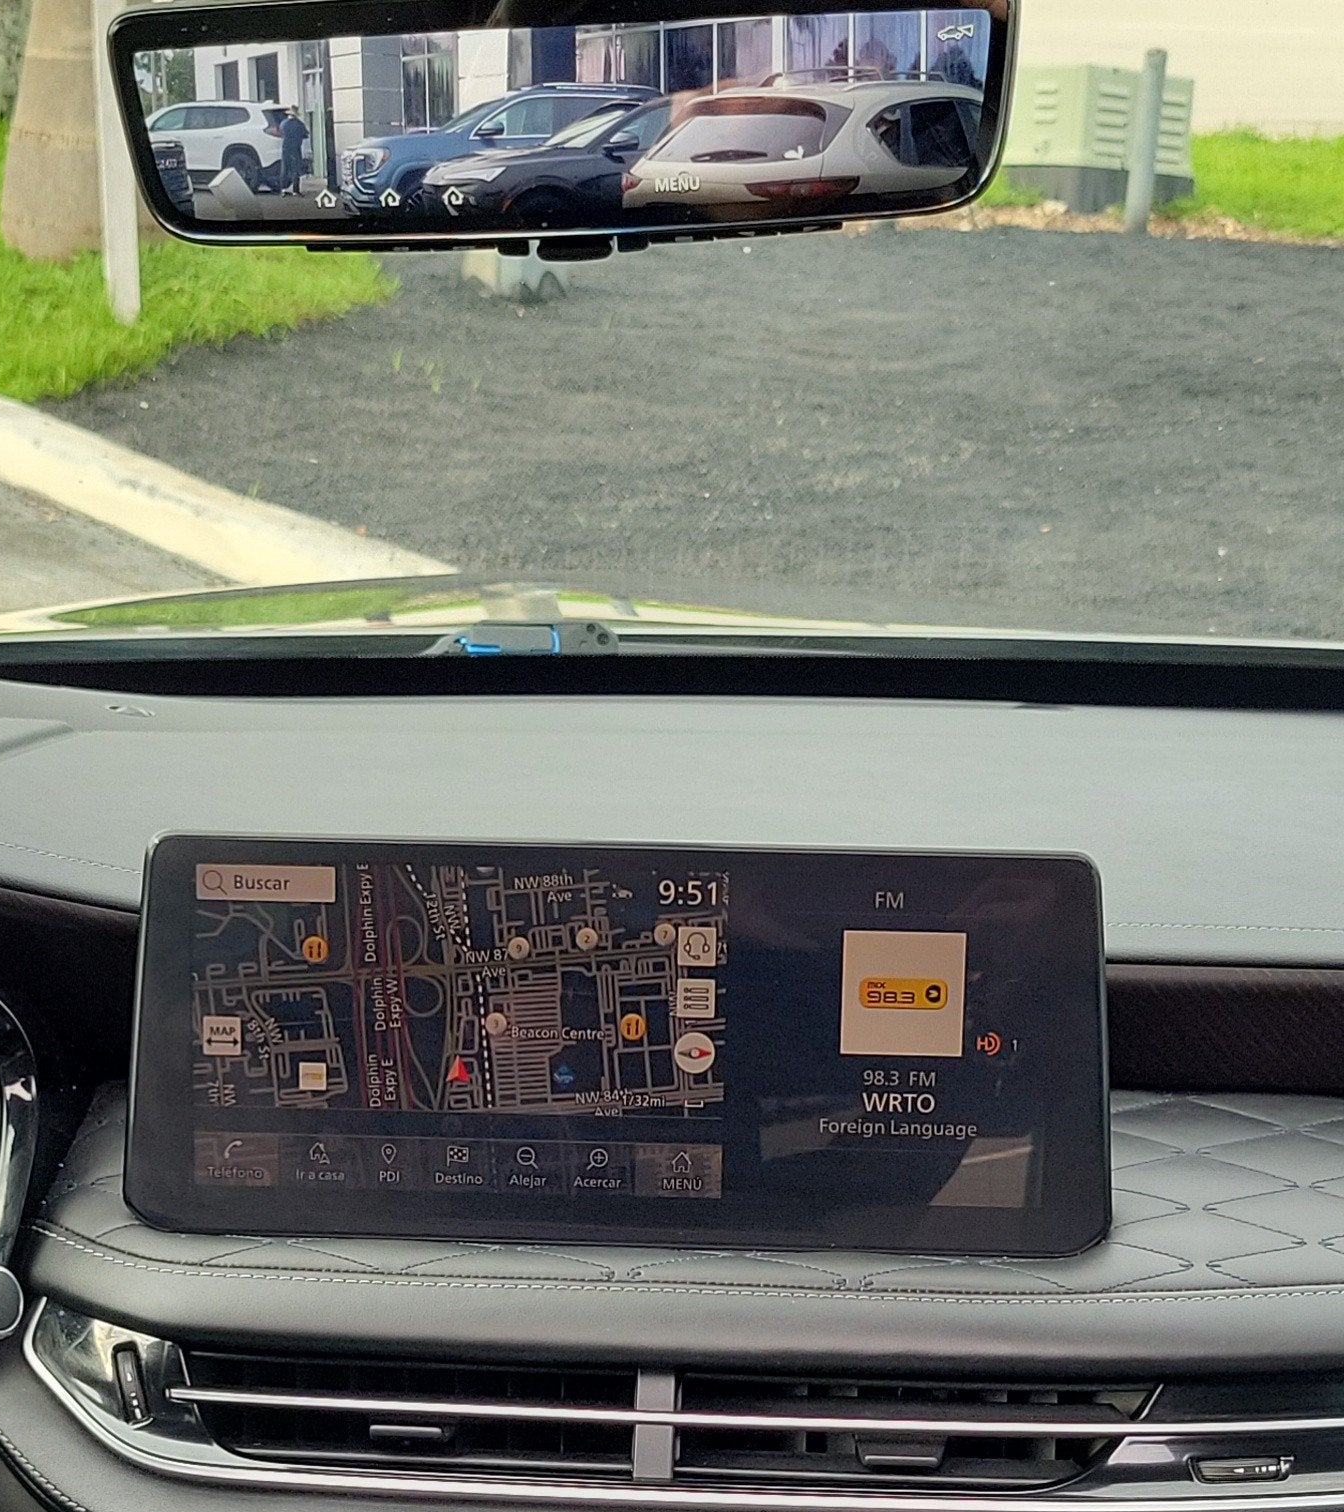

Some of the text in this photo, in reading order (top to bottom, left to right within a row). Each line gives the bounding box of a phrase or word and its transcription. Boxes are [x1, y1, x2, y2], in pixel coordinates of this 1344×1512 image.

[655, 177, 700, 192] MENU
[233, 875, 291, 890] Buscar
[359, 874, 374, 906] Expy
[514, 875, 573, 891] NW 88th
[547, 891, 573, 903] Ave
[658, 879, 717, 906] 9:51
[874, 891, 905, 909] FM
[362, 909, 377, 963] Dolphin
[465, 950, 491, 964] NW
[481, 966, 506, 978] Ave
[371, 977, 387, 1032] Dolphin
[390, 996, 403, 1029] Expy
[209, 1026, 237, 1036] MAP
[511, 1026, 606, 1041] Beacon Centre
[367, 1053, 382, 1108] Dolphin
[383, 1068, 398, 1101] Expy
[862, 1070, 936, 1087] 98.3 FM
[575, 1091, 599, 1105] NW
[862, 1092, 935, 1113] WRTO
[819, 1117, 978, 1139] Foreign Language
[318, 1171, 345, 1182] casa
[379, 1171, 400, 1183] PDI
[435, 1172, 484, 1185] Destino
[509, 1174, 547, 1189] Alejar
[573, 1176, 623, 1189] Acercar
